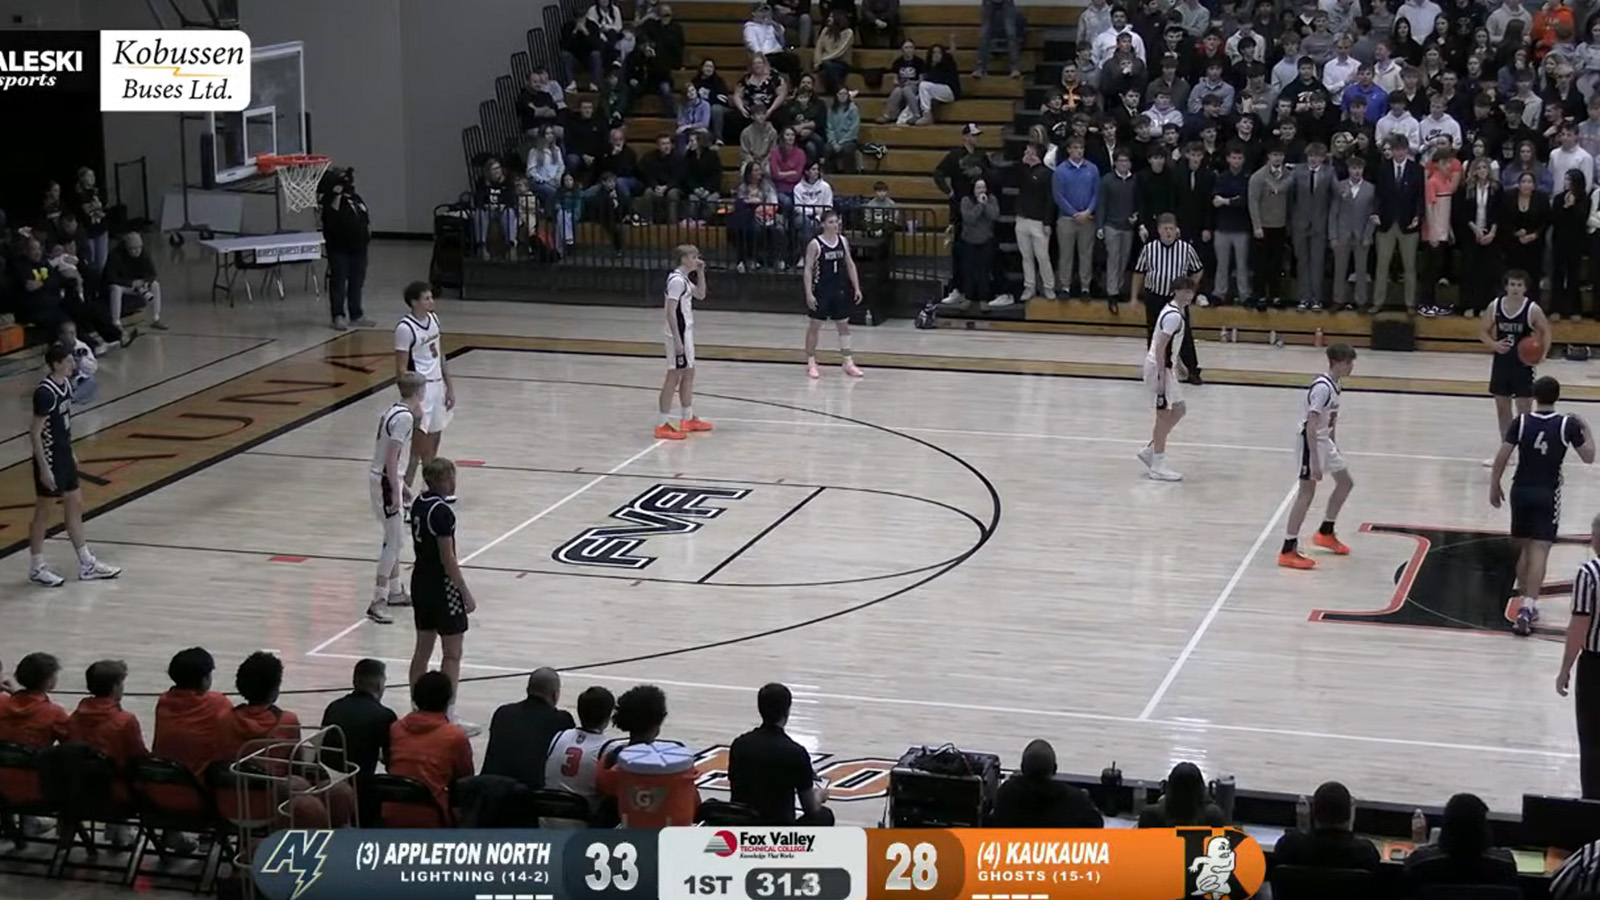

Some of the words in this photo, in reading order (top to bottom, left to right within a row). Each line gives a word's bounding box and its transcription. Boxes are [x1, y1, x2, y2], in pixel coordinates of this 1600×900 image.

[1534, 430, 1549, 455] 4
[551, 483, 754, 570] FVA
[561, 746, 583, 777] 3
[636, 790, 652, 808] G
